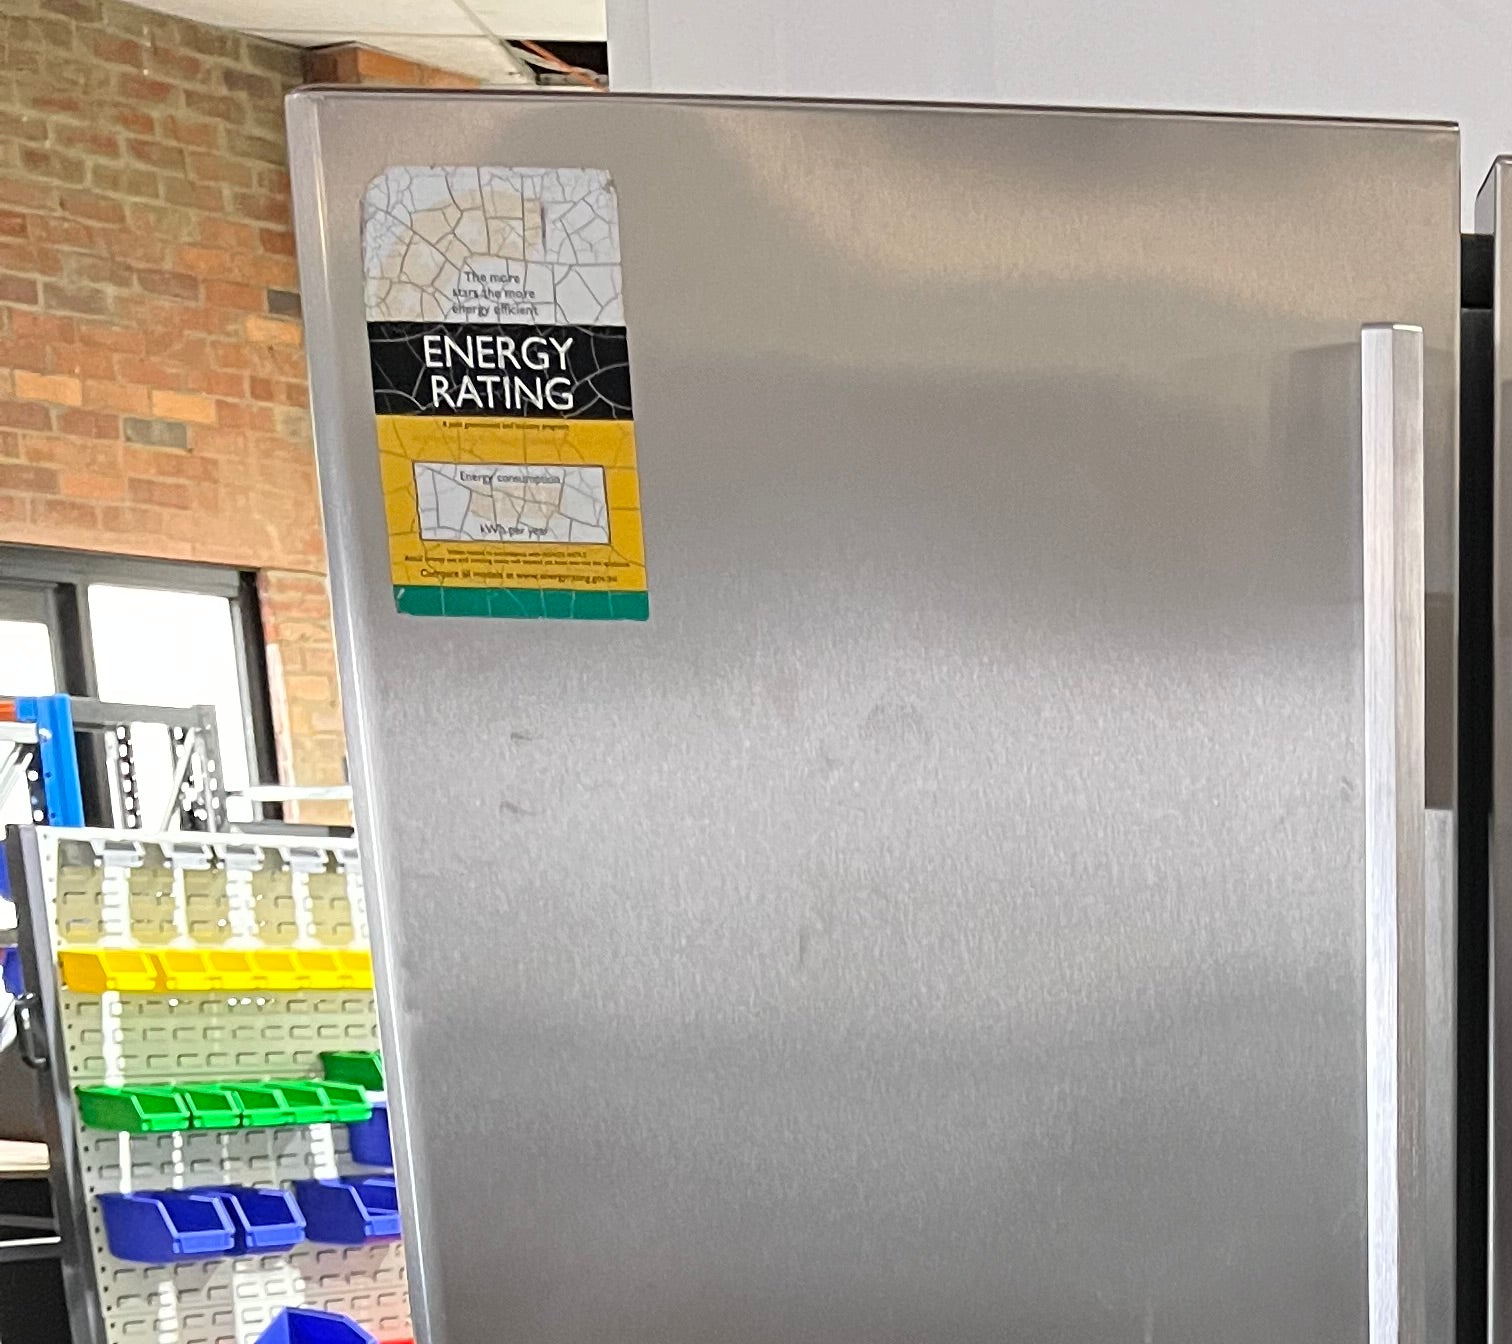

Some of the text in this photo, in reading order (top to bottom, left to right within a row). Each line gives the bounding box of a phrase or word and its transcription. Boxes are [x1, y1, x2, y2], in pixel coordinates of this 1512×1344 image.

[463, 271, 521, 283] The more
[481, 286, 502, 299] the
[504, 288, 536, 299] more
[451, 302, 539, 317] energy efficient
[423, 334, 574, 371] ENERGY
[430, 374, 575, 411] RATING
[460, 470, 561, 486] Energy consumption
[508, 526, 525, 537] per
